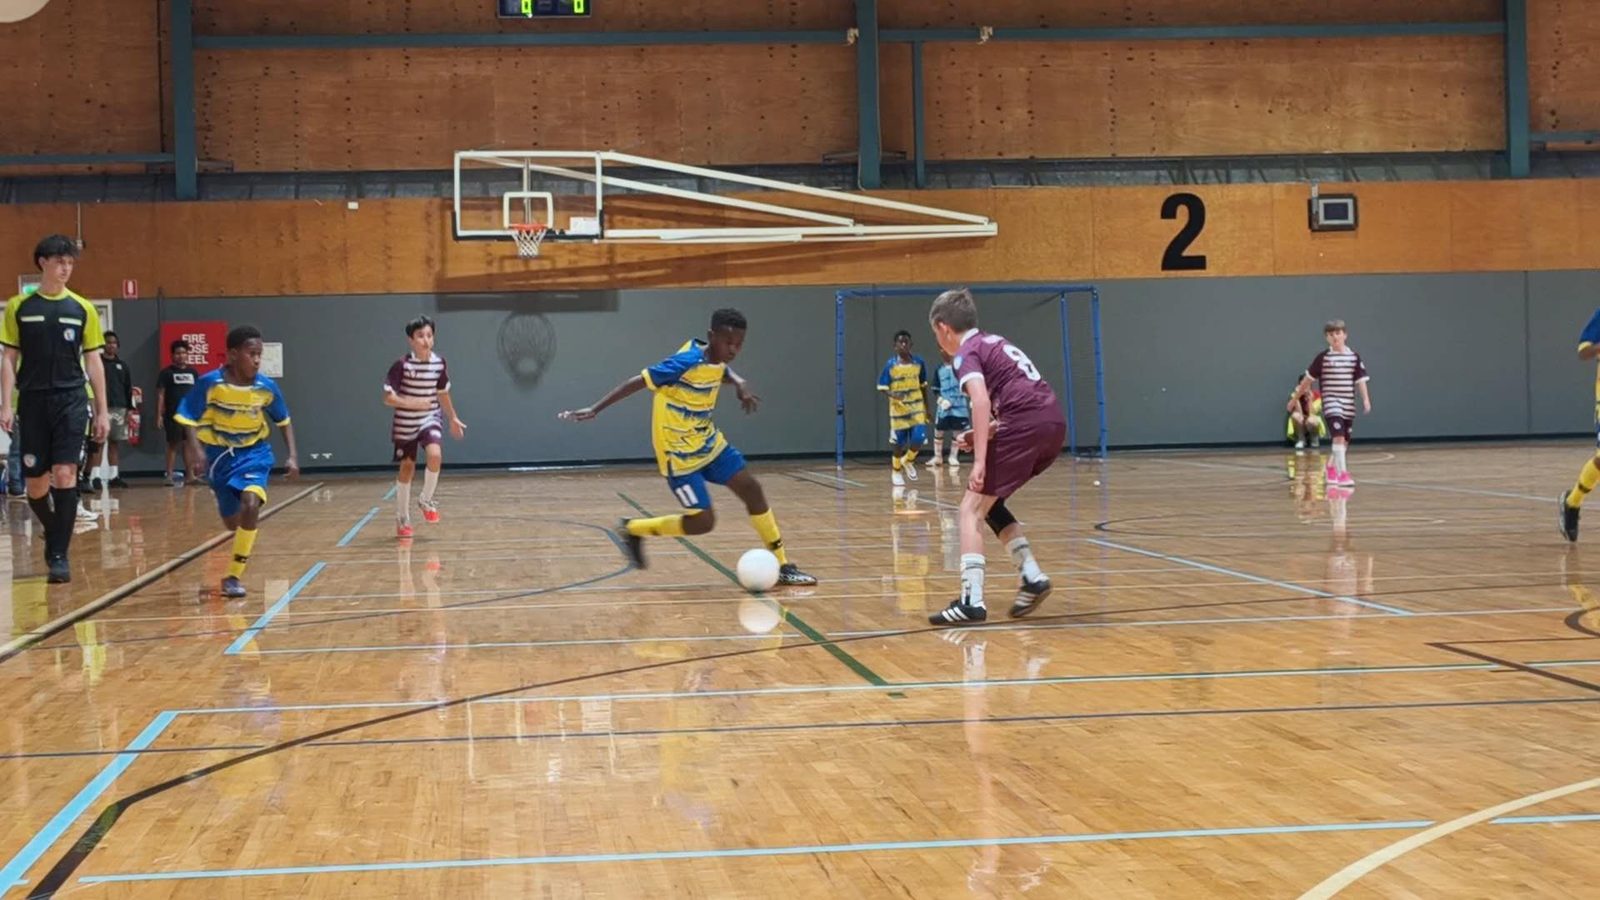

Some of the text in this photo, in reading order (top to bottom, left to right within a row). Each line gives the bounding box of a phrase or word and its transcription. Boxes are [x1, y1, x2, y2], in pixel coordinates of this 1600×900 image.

[1160, 192, 1206, 271] 2
[182, 333, 206, 343] FIRE
[186, 344, 209, 354] OSE
[185, 355, 209, 365] EEL
[1003, 344, 1041, 381] 8
[675, 484, 699, 507] 11
